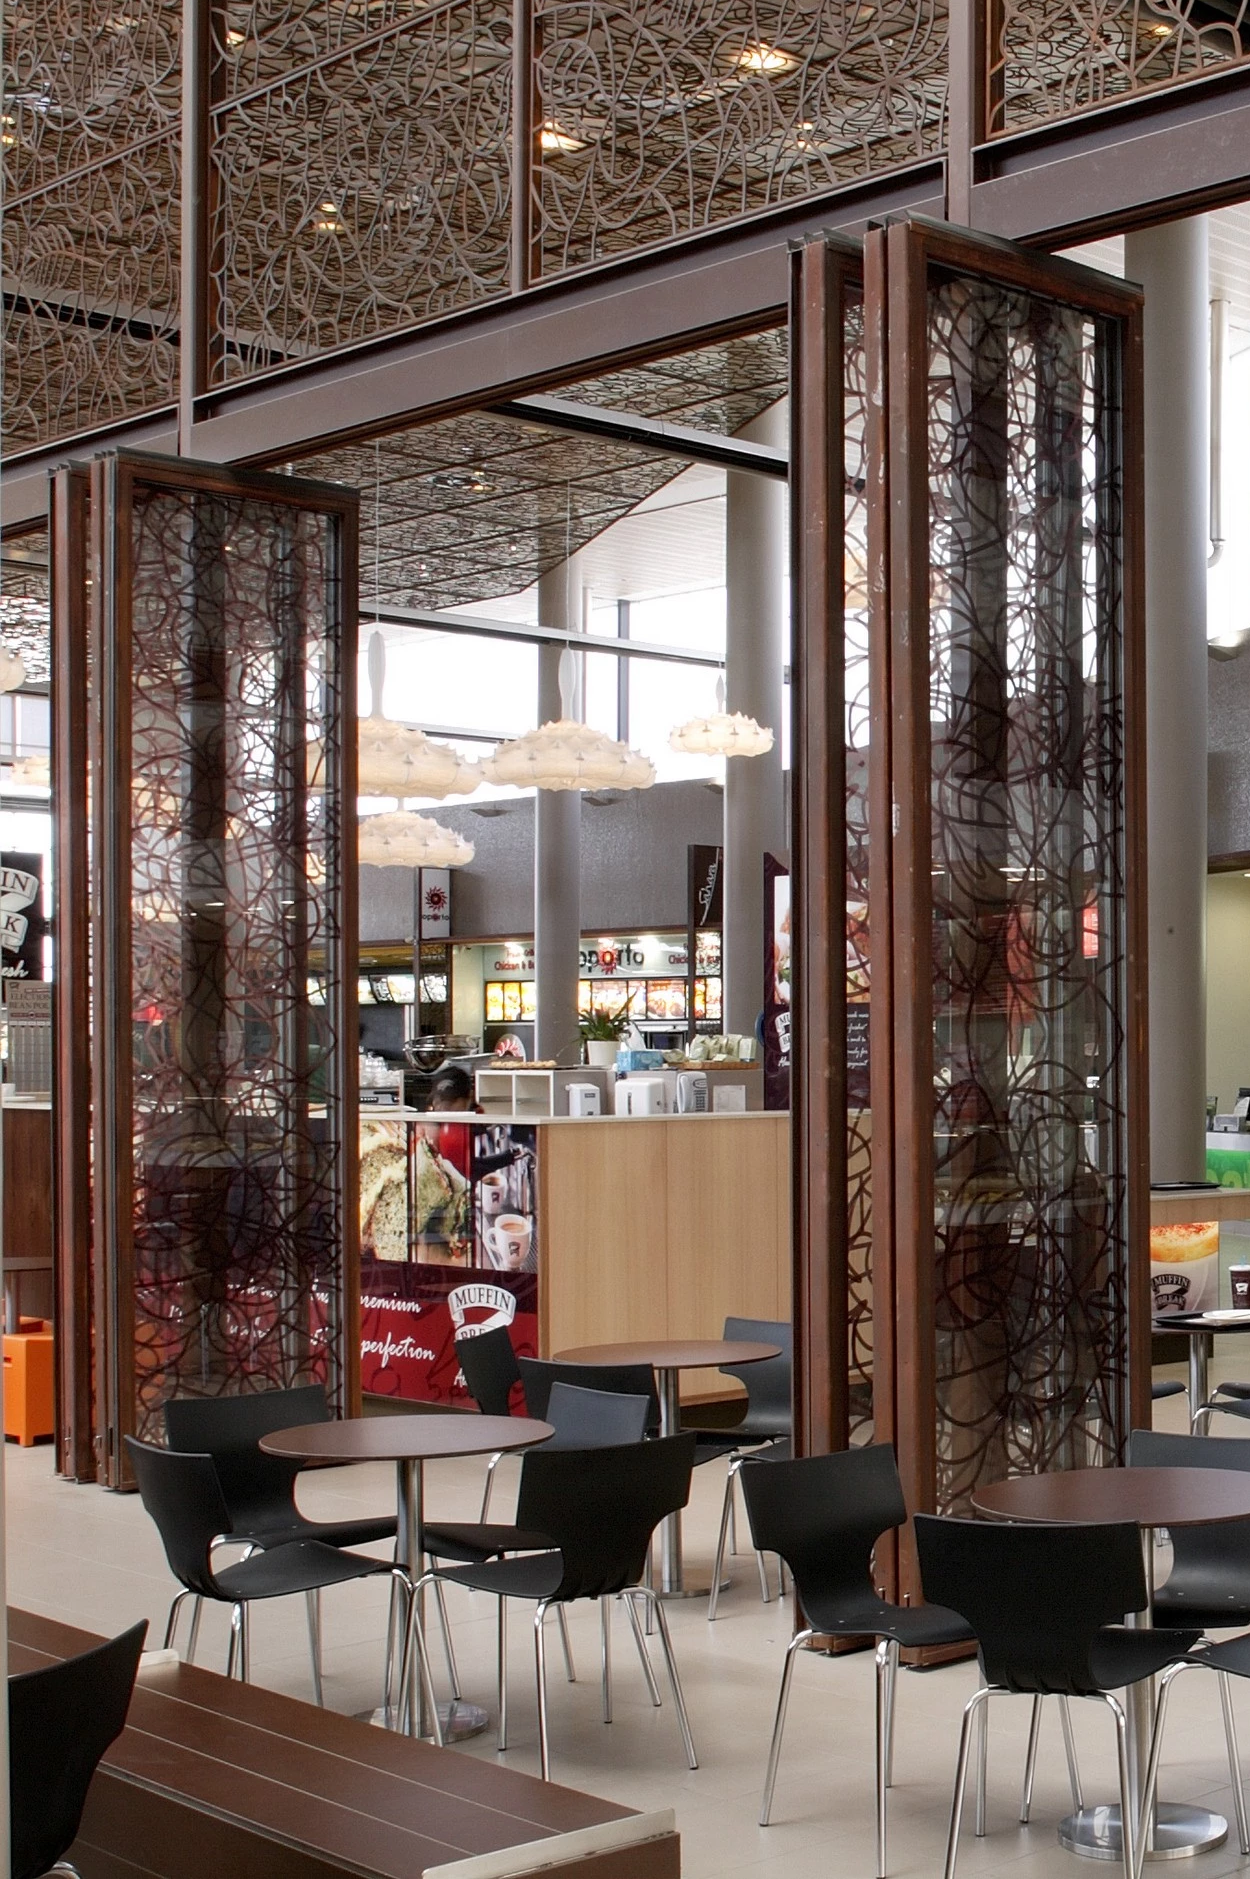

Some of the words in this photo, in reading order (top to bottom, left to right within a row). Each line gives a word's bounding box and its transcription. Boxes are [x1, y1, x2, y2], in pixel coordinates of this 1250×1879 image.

[1153, 1276, 1188, 1289] MUFFIN
[455, 1287, 512, 1312] MUFFIN
[361, 1332, 436, 1368] perfection
